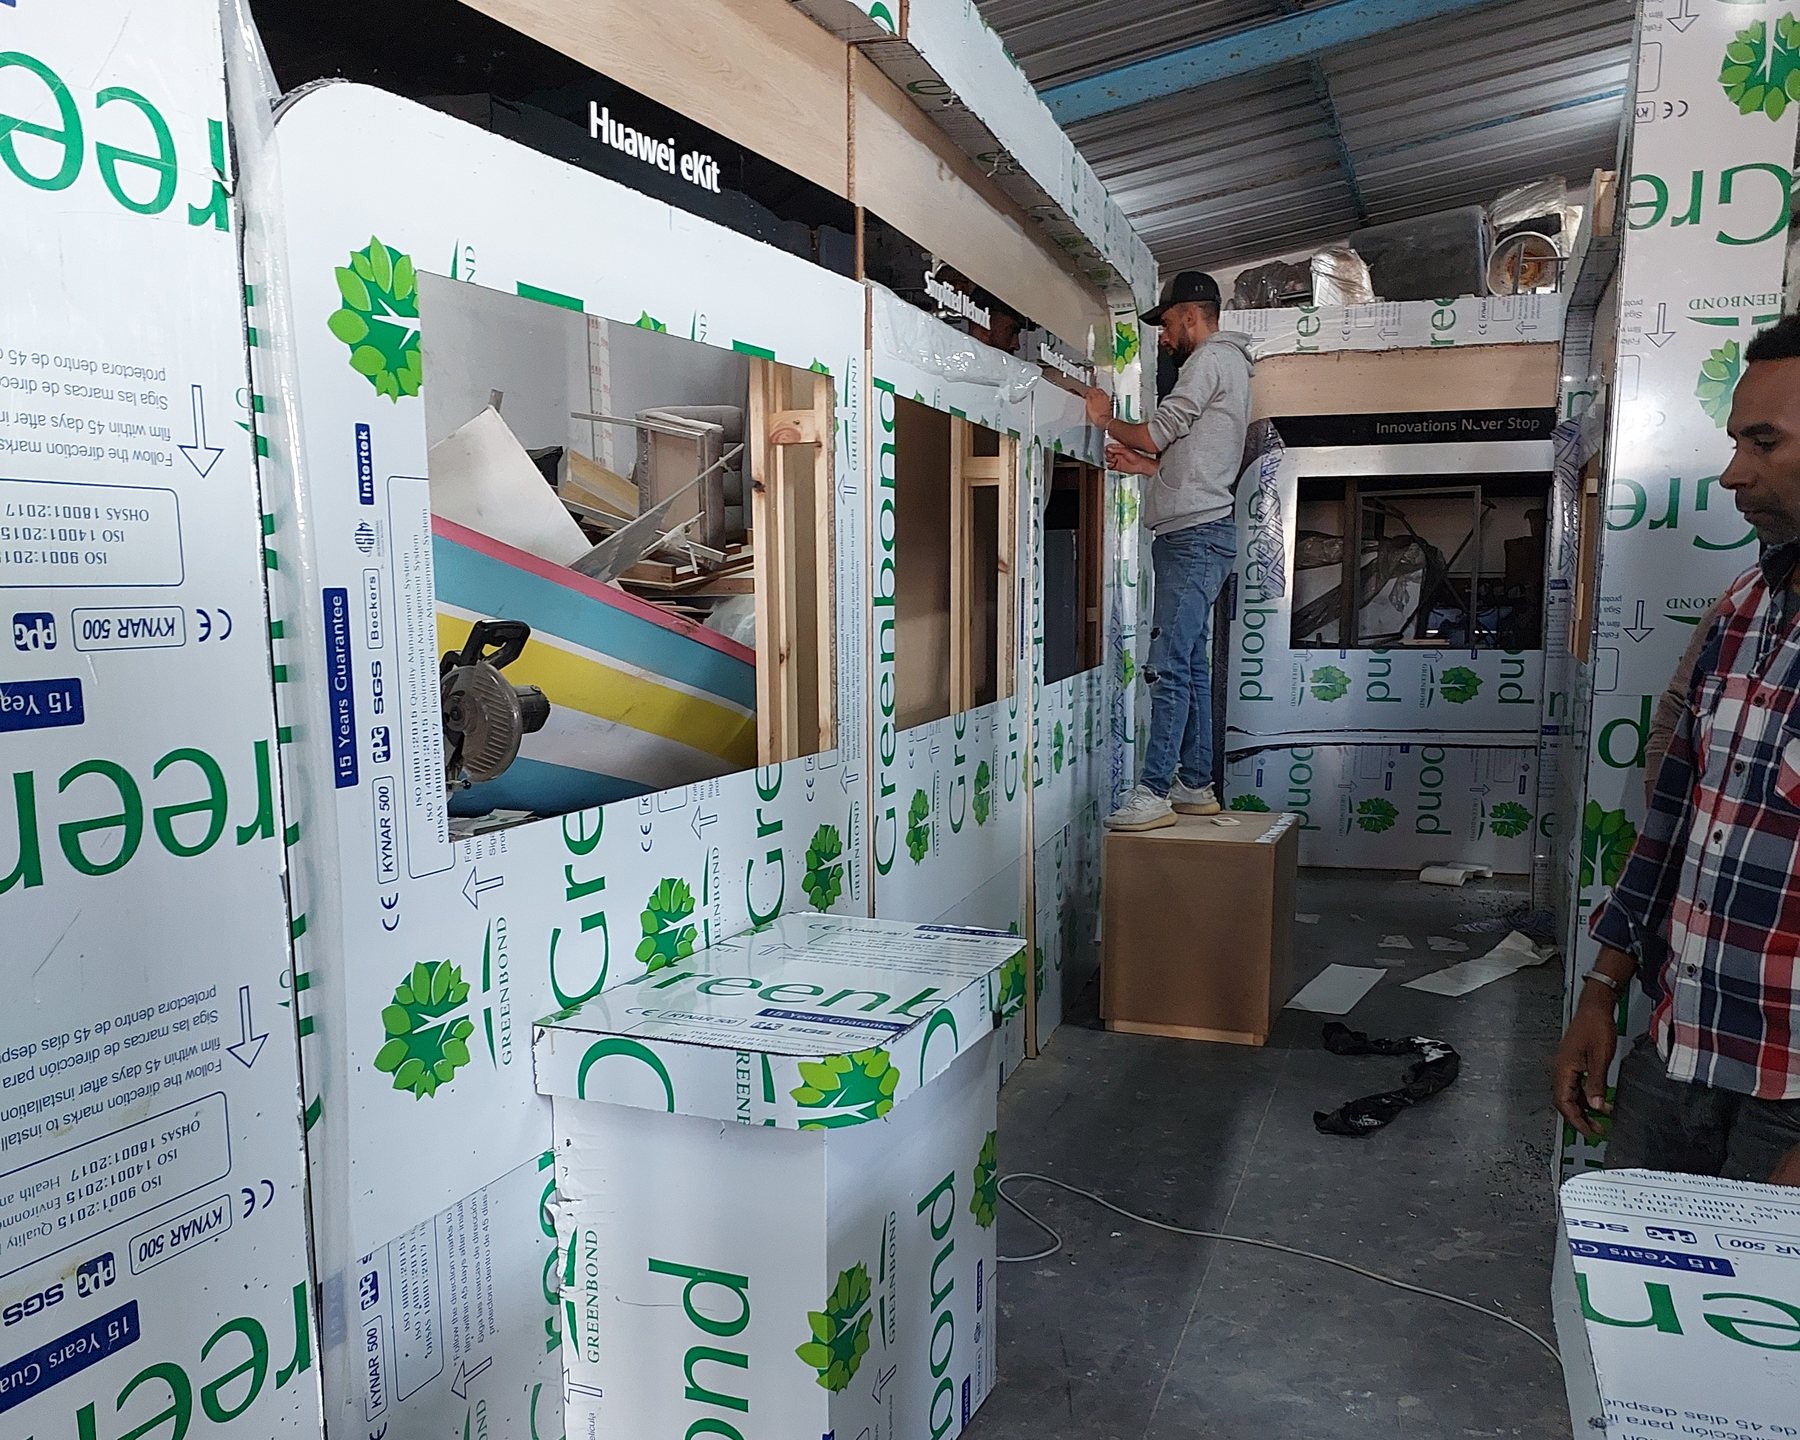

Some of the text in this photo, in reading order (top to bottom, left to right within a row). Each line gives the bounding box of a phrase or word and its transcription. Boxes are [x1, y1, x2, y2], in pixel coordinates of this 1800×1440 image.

[589, 101, 721, 193] Huawei eKit
[1687, 293, 1784, 310] EENBOND
[8, 350, 166, 381] protectora dentro de 45
[42, 381, 168, 410] Siga las marcas de
[14, 412, 171, 442] film within 45 days after
[1376, 416, 1540, 434] Innovations Nver Stop
[46, 441, 104, 461] direction
[108, 447, 129, 463] the
[132, 449, 173, 467] Follow
[6, 504, 149, 521] OHSAS 18001:2017
[1, 527, 124, 543] ISO 14001:2015
[0, 551, 107, 566] ISO 9001:201
[83, 616, 176, 640] KYNAR 500
[331, 595, 353, 778] 15 Years Guarantee
[371, 660, 384, 715] SGS
[48, 691, 73, 713] 15
[378, 786, 394, 873] KYNAR 500
[853, 800, 861, 901] GREENBOND
[497, 916, 512, 1065] GREENBOND
[41, 985, 217, 1052] protectora dentro de 45 días
[788, 1012, 825, 1024] Years
[827, 1015, 901, 1032] Guarantee
[3, 1010, 218, 1089] Siga las marcas de dirección para
[1, 1037, 221, 1122] film within 45 days after installation
[163, 1073, 182, 1089] the
[185, 1059, 222, 1082] Follow
[107, 1082, 160, 1109] direction
[46, 1118, 59, 1132] to
[63, 1099, 104, 1125] marks
[20, 1120, 200, 1202] OHSAS 18001:2017 Health
[66, 1148, 178, 1205] ISO 14001:2015
[7, 1176, 161, 1250] ISO 9001:2015 Quality
[139, 1206, 223, 1262] KYNAR 500
[1729, 1238, 1765, 1251] 500
[1609, 1246, 1719, 1272] 15 Years
[888, 1210, 898, 1345] GREENBOND
[3, 1284, 64, 1327] SGS
[585, 1230, 600, 1364] GREENBOND
[48, 1315, 130, 1370] 15 Years
[366, 1327, 378, 1351] 500
[368, 1357, 383, 1409] KYNAR
[1735, 1420, 1763, 1432] 45
